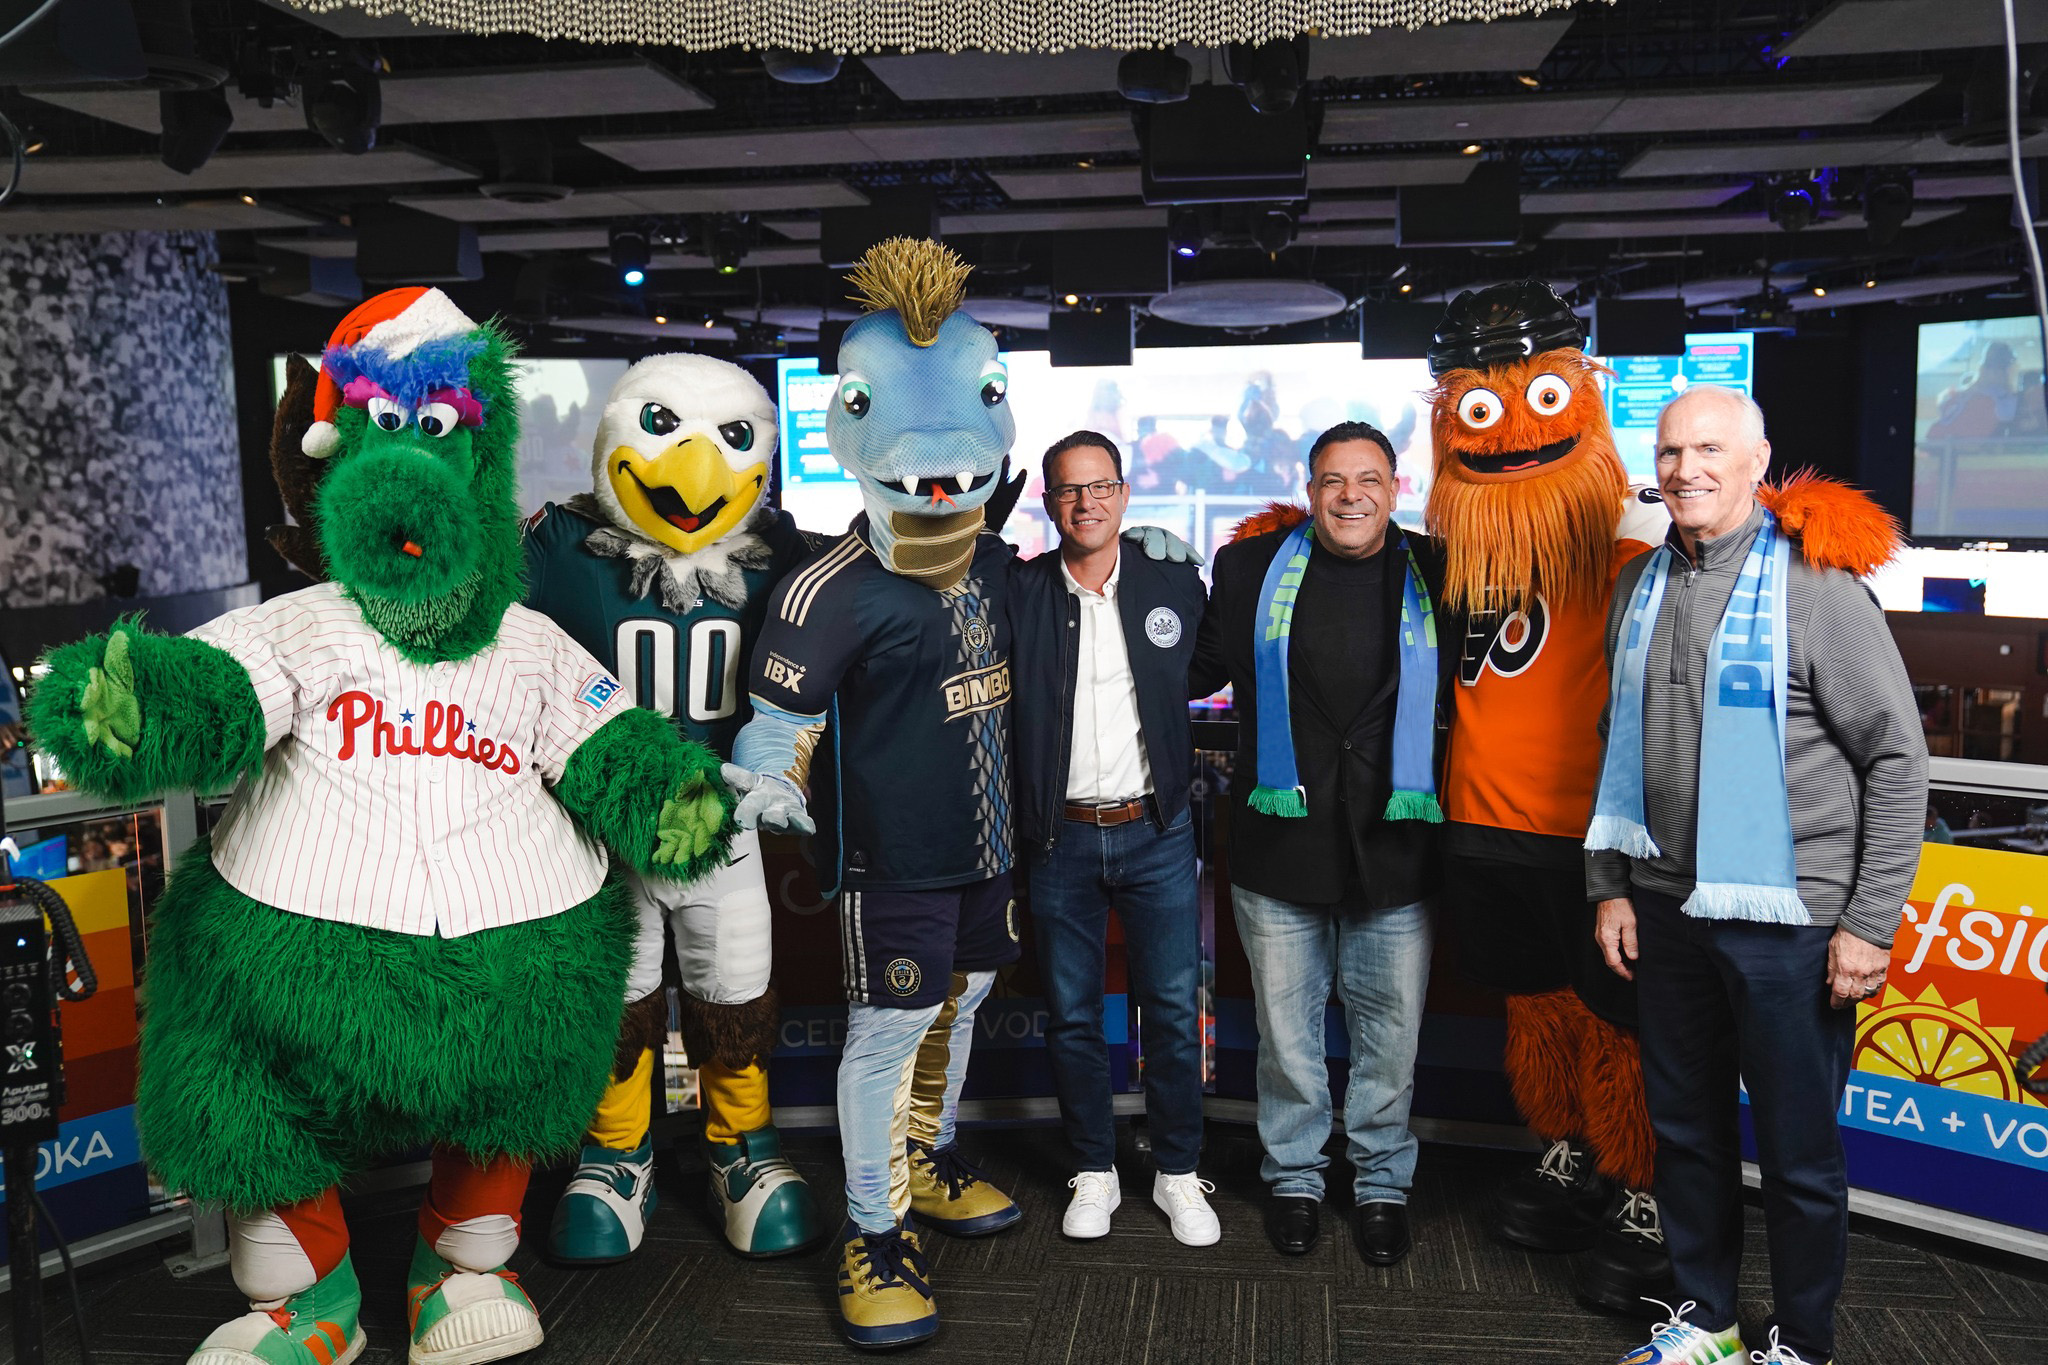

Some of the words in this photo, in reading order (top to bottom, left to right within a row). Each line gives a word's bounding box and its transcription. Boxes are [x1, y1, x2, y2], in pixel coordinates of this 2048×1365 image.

[615, 619, 741, 722] 00
[764, 657, 804, 694] IBX
[769, 650, 800, 670] Independence
[584, 676, 620, 709] IBX
[945, 667, 1010, 712] BIMBO
[326, 690, 521, 775] Phillies
[1844, 1084, 1925, 1132] TEA
